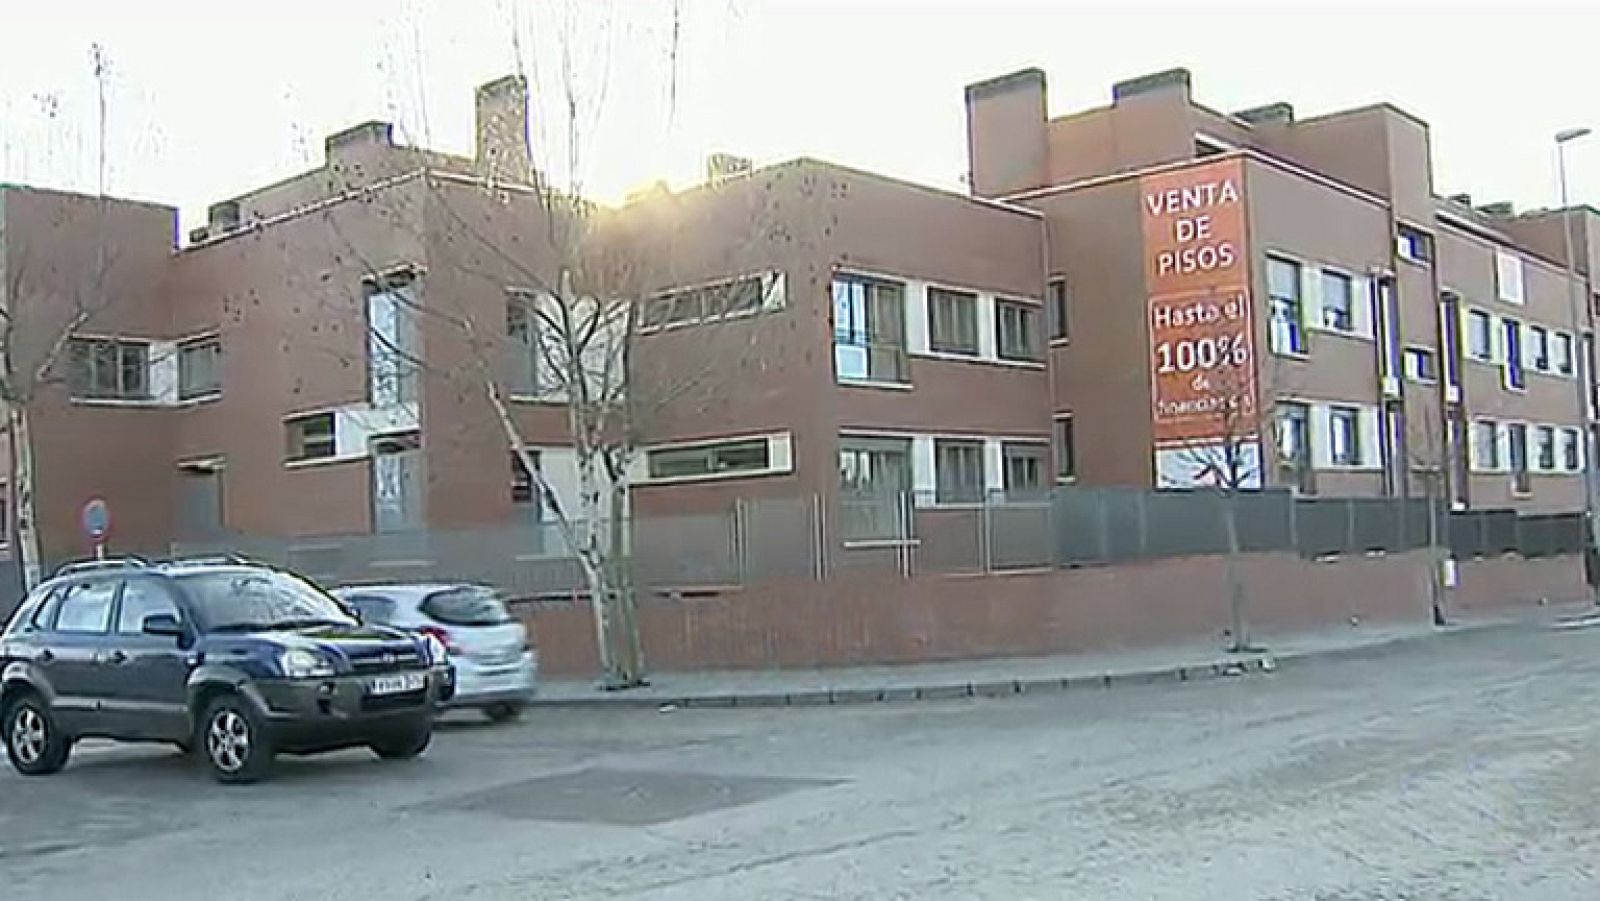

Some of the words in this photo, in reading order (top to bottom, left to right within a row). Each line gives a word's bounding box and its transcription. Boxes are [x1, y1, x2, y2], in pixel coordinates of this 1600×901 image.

[1147, 180, 1238, 215] VENTA
[1176, 216, 1211, 241] DE
[1159, 243, 1234, 276] PISOS
[1154, 302, 1219, 328] Hasta
[1224, 293, 1244, 319] el
[1157, 333, 1247, 373] 100%
